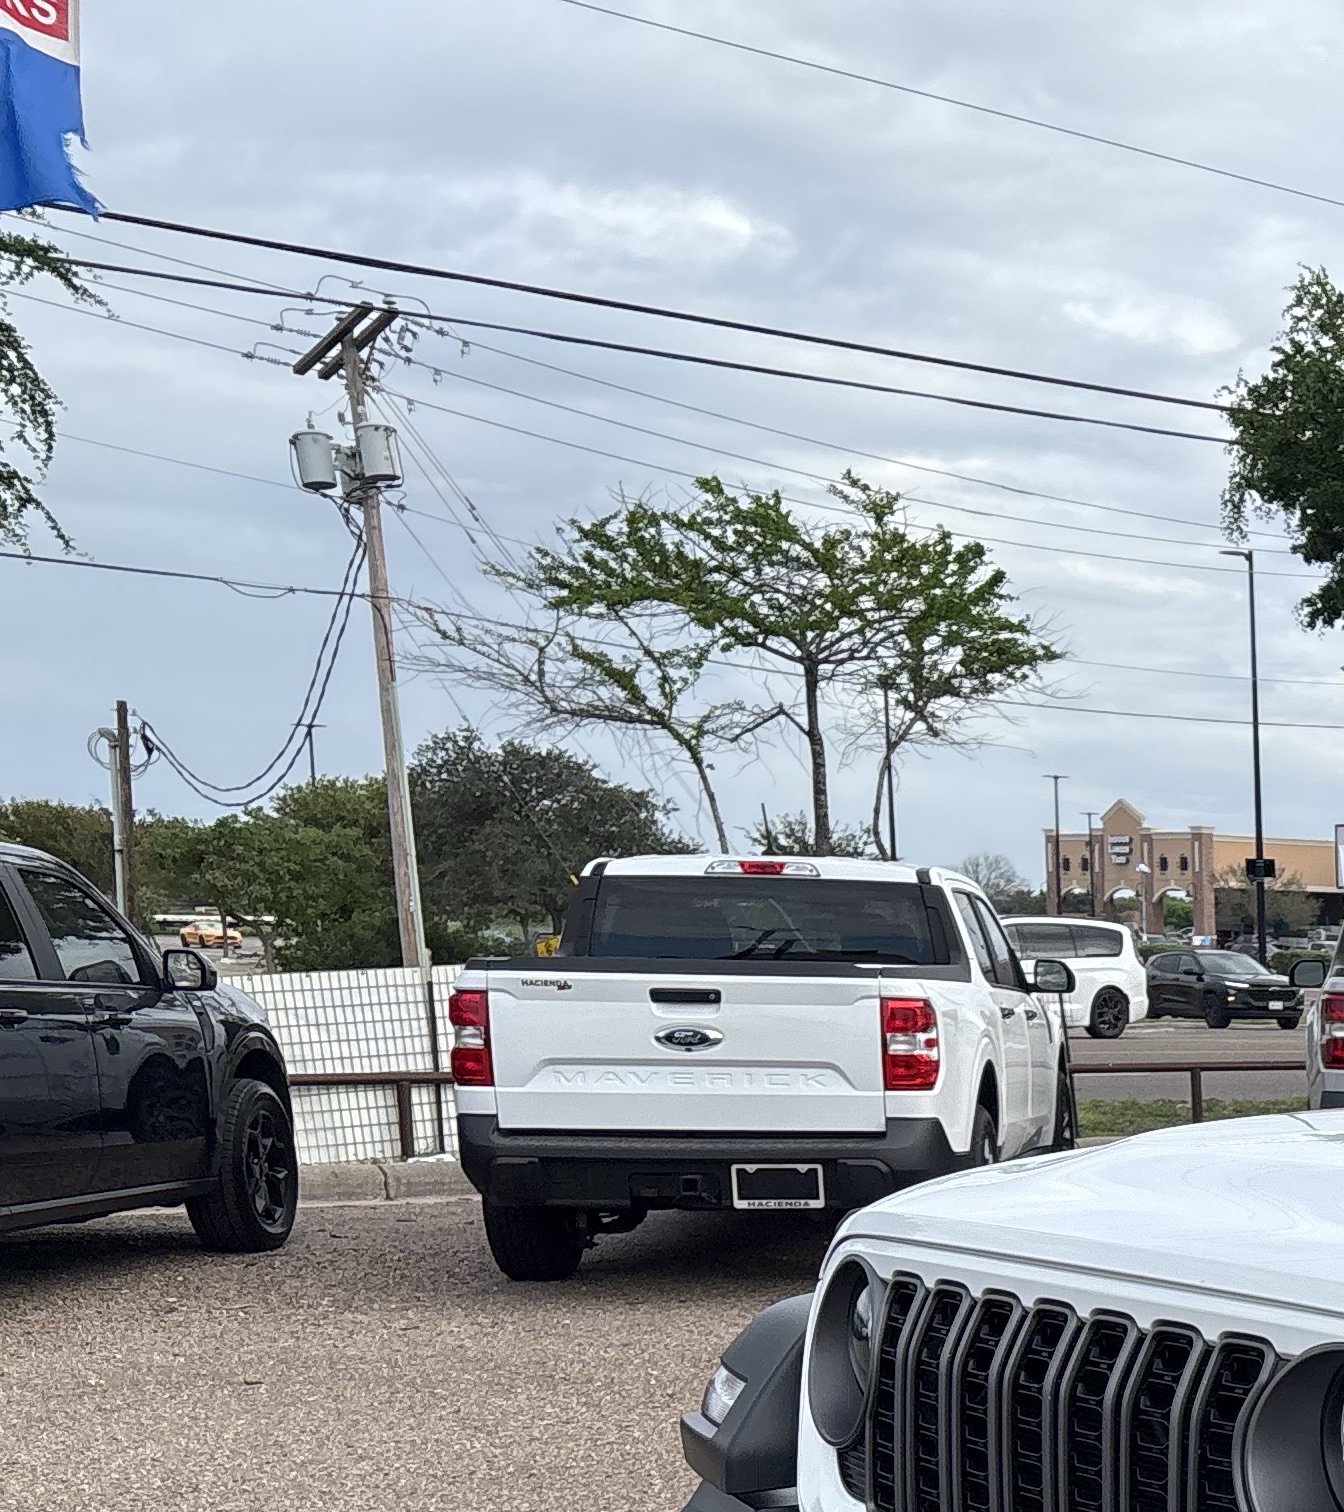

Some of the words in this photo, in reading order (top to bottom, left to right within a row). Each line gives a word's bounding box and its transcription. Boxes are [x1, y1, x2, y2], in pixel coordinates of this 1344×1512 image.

[520, 979, 569, 987] HACIENDA
[672, 1031, 702, 1044] Ford
[551, 1070, 829, 1088] MAVERICK
